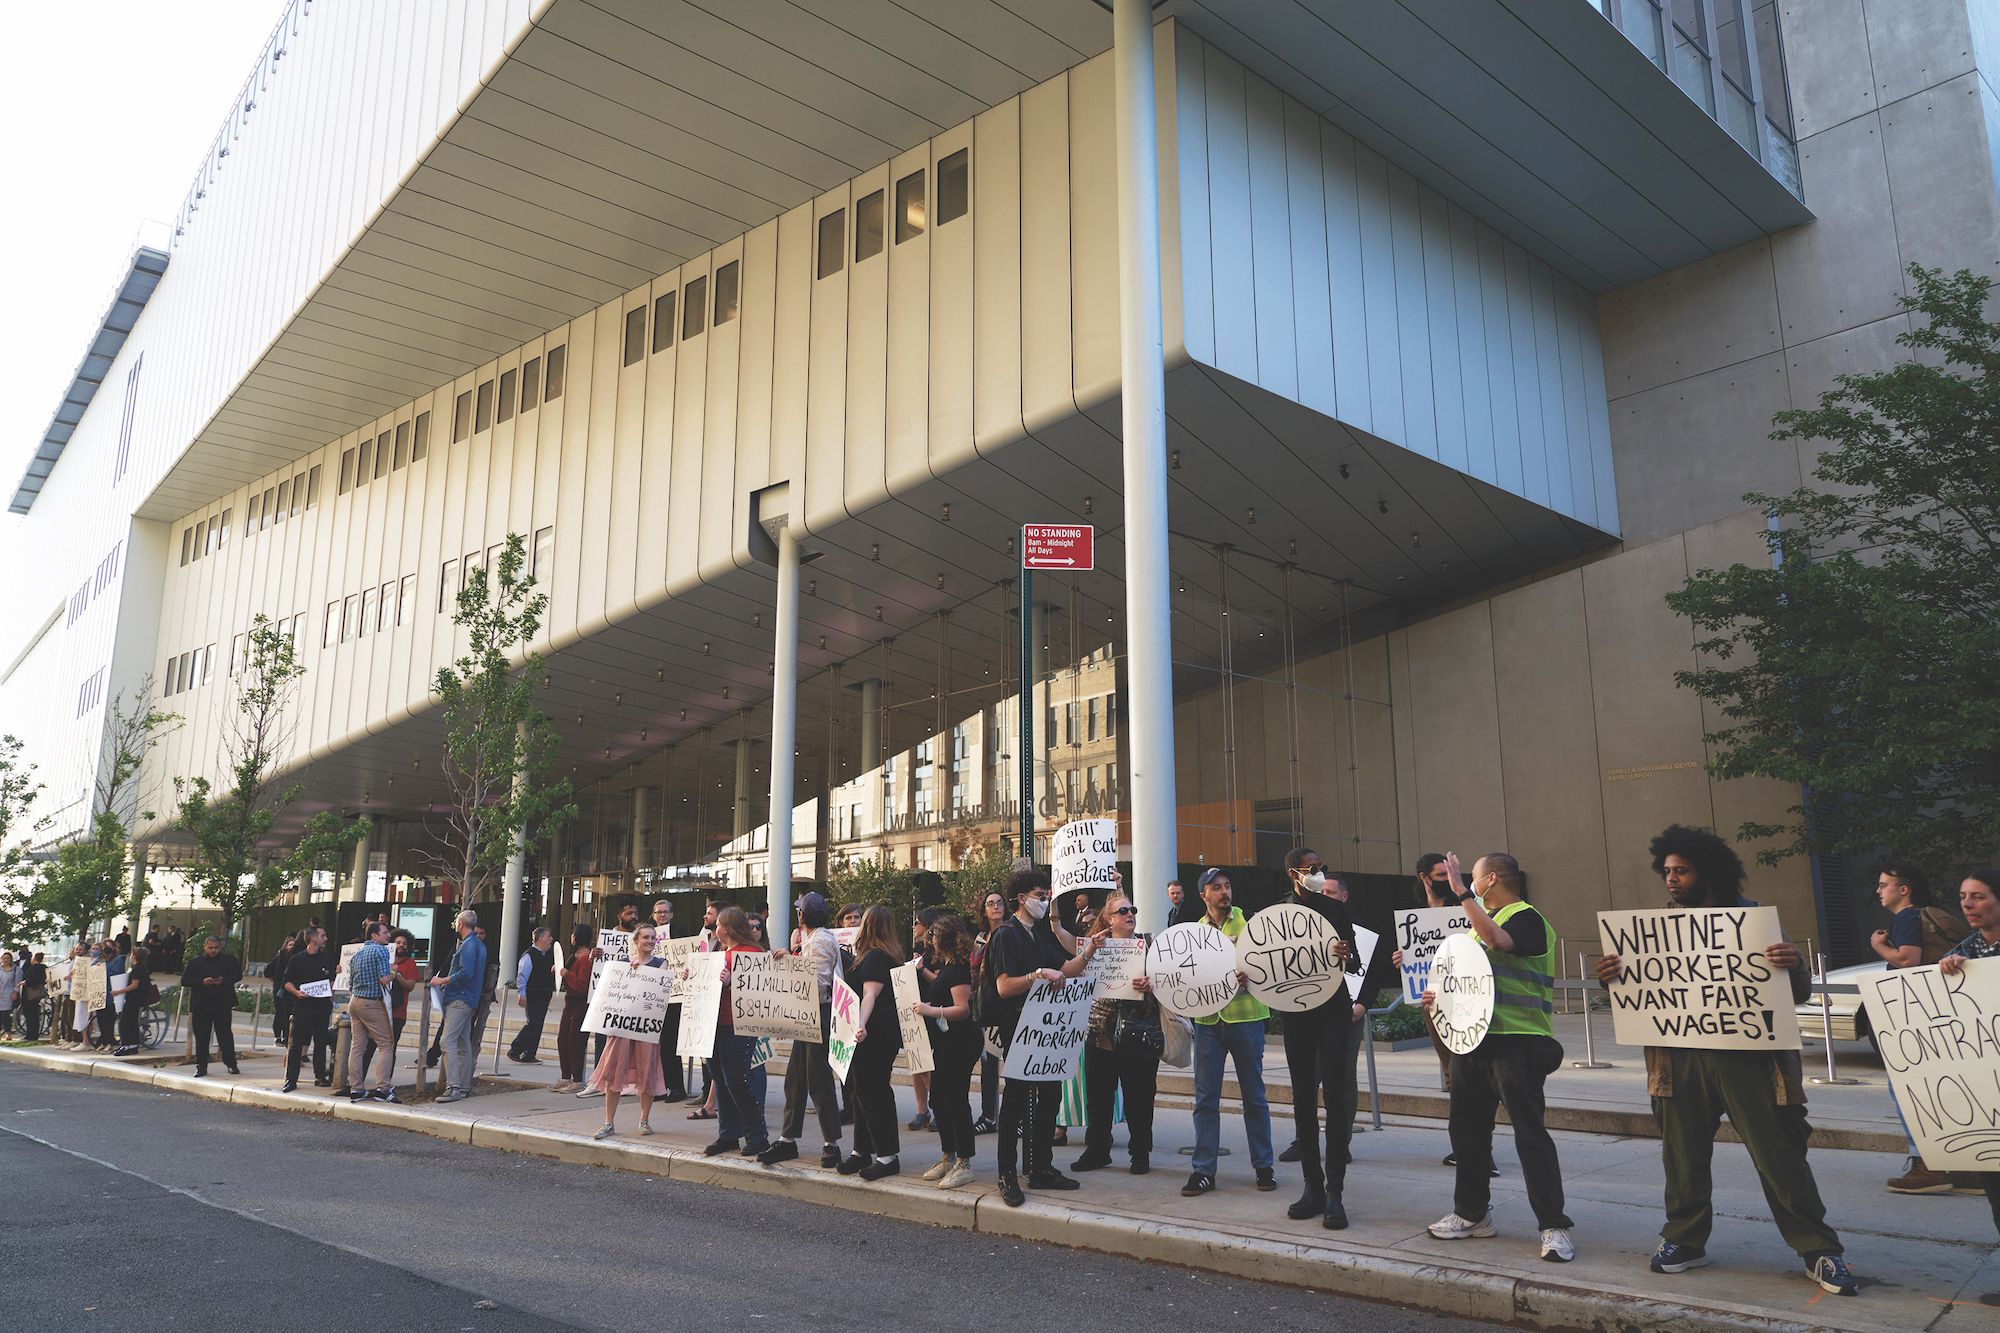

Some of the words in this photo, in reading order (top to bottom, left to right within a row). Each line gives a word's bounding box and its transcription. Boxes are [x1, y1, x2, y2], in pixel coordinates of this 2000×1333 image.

[1027, 528, 1039, 537] NO
[1041, 529, 1081, 538] STANDING
[1047, 539, 1074, 548] Midnight
[1038, 547, 1053, 555] Days
[890, 809, 934, 832] WHAT
[600, 932, 629, 946] THER
[1247, 910, 1323, 946] UNION
[1601, 911, 1746, 957] WHITNEY
[1156, 926, 1223, 962] HONK!
[595, 952, 630, 963] ARTIS
[733, 953, 771, 972] ADAM
[1179, 953, 1198, 977] 4
[1244, 936, 1343, 985] STRONG
[1437, 956, 1456, 975] FAIR
[1100, 972, 1129, 980] Benefits
[1155, 971, 1187, 989] FAIR
[1618, 952, 1772, 986] WORKERS
[642, 991, 657, 1001] $20
[736, 974, 760, 991] $1.1
[762, 976, 812, 996] MILLION
[1409, 976, 1428, 1000] LI
[1443, 974, 1494, 996] CONTRACT
[1613, 987, 1688, 1011] WANT
[1701, 985, 1765, 1009] FAIR
[1875, 968, 1982, 1031] FAIR
[735, 997, 771, 1018] $89.4
[773, 1004, 817, 1024] MILLION
[602, 1012, 663, 1034] PRICELESS
[1432, 1003, 1490, 1052] YESTERDAY
[1652, 1010, 1776, 1041] WAGES!
